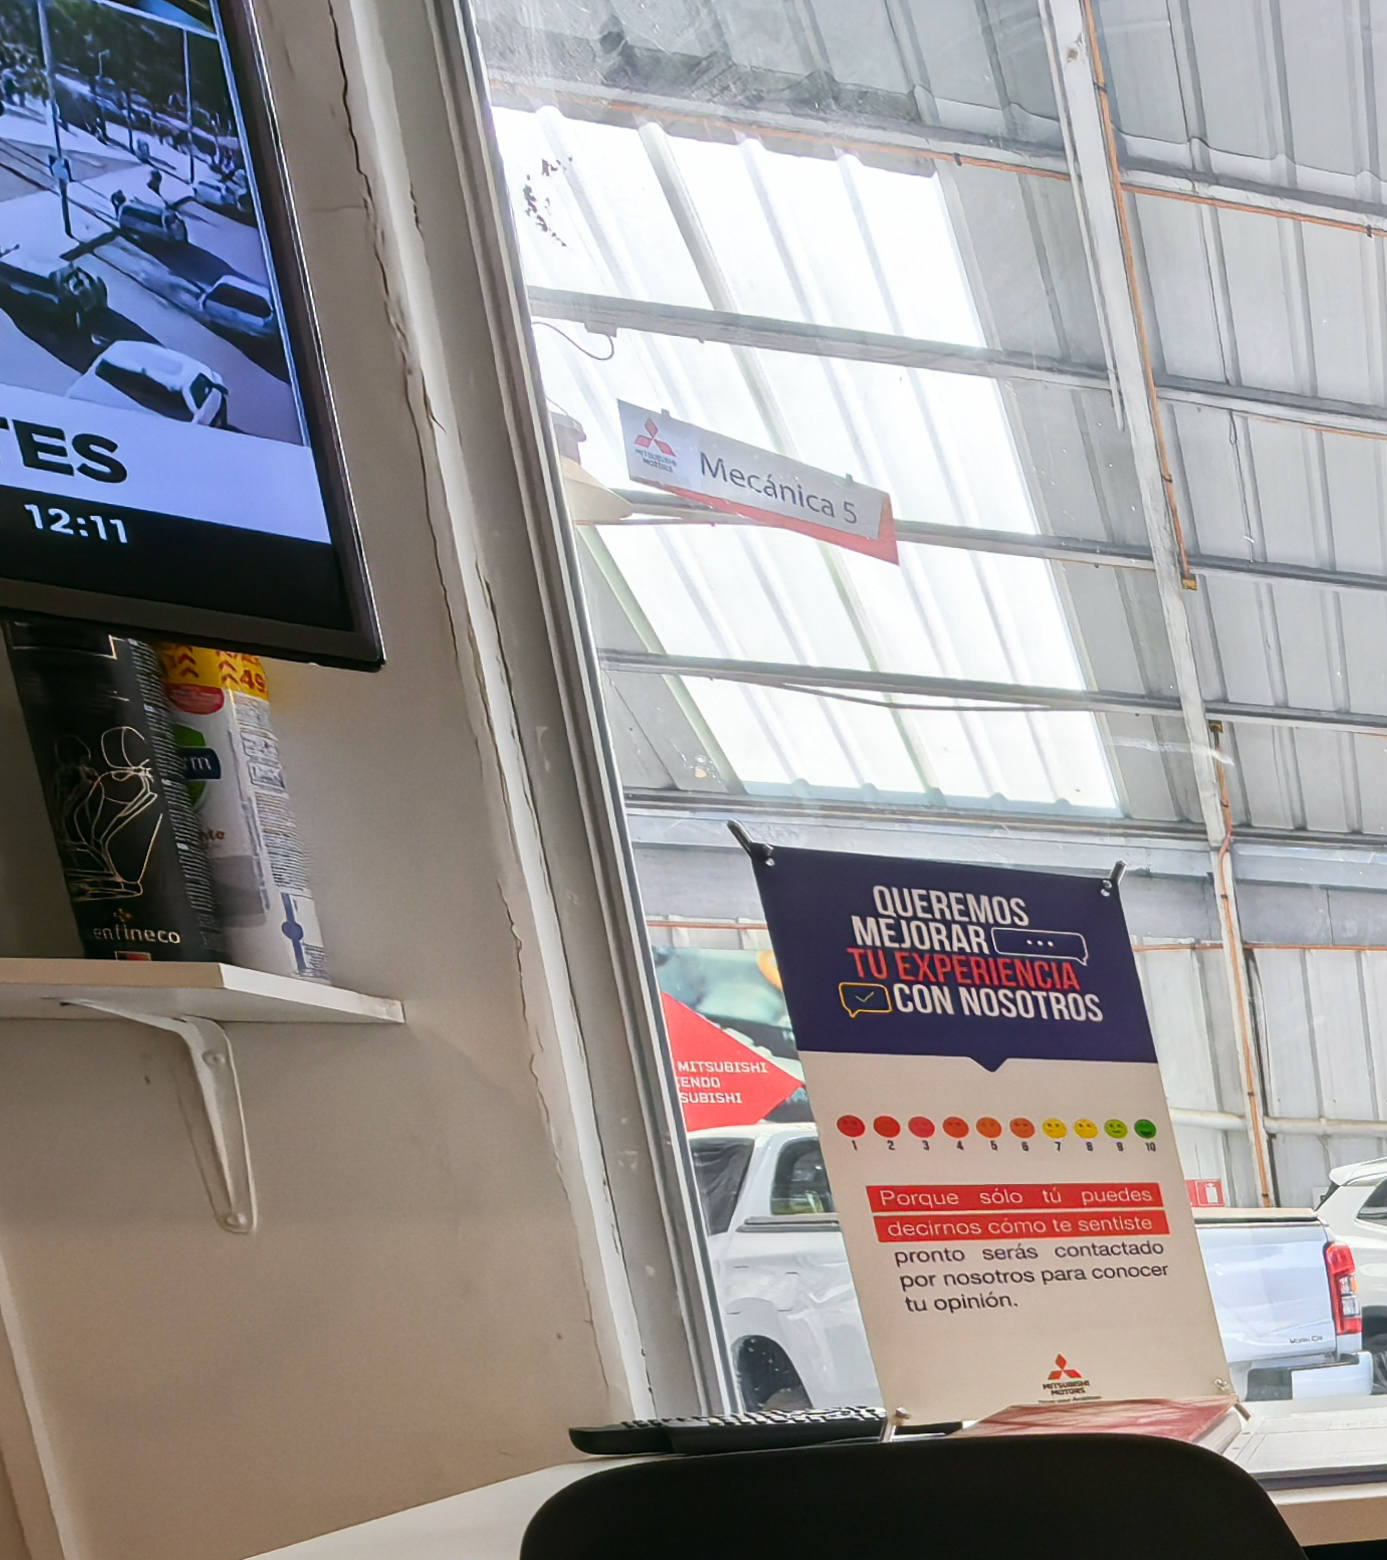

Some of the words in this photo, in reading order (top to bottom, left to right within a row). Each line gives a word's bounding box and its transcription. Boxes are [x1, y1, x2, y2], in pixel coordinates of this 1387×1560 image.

[0, 417, 127, 483] ES
[700, 451, 835, 518] Mecánica
[843, 503, 858, 525] 5
[24, 504, 128, 543] 12:11
[873, 885, 1029, 926] QUEREMOS
[851, 915, 990, 954] MEJORAR
[847, 948, 888, 980] TU
[894, 951, 1081, 990] EXPERIENCIA
[893, 983, 955, 1015] CON
[960, 988, 1104, 1022] NOSOTROS
[677, 1061, 768, 1074] MITSUBISHI
[851, 1140, 858, 1151] 1
[886, 1140, 896, 1151] 2
[921, 1140, 930, 1151] 3
[955, 1140, 965, 1151] 4
[990, 1140, 998, 1151] 5
[1021, 1140, 1029, 1151] 6
[1053, 1140, 1062, 1151] 7
[1085, 1140, 1094, 1151] 8
[1146, 1140, 1157, 1151] 10
[879, 1189, 959, 1208] Porque
[979, 1188, 1023, 1205] sólo
[1042, 1187, 1062, 1204] tú
[1081, 1187, 1153, 1206] puedes
[887, 1219, 982, 1237] decirnos
[988, 1216, 1047, 1235] cómo
[1052, 1218, 1073, 1232] te
[1078, 1216, 1153, 1232] sentiste
[894, 1247, 966, 1268] pronto
[982, 1243, 1039, 1261] serás
[1054, 1240, 1165, 1259] contactado
[900, 1274, 936, 1292] por
[943, 1269, 1036, 1287] nosotros
[1040, 1268, 1087, 1285] para
[1091, 1263, 1169, 1280] conocer
[905, 1296, 928, 1313] tu
[934, 1291, 1019, 1314] opinión.
